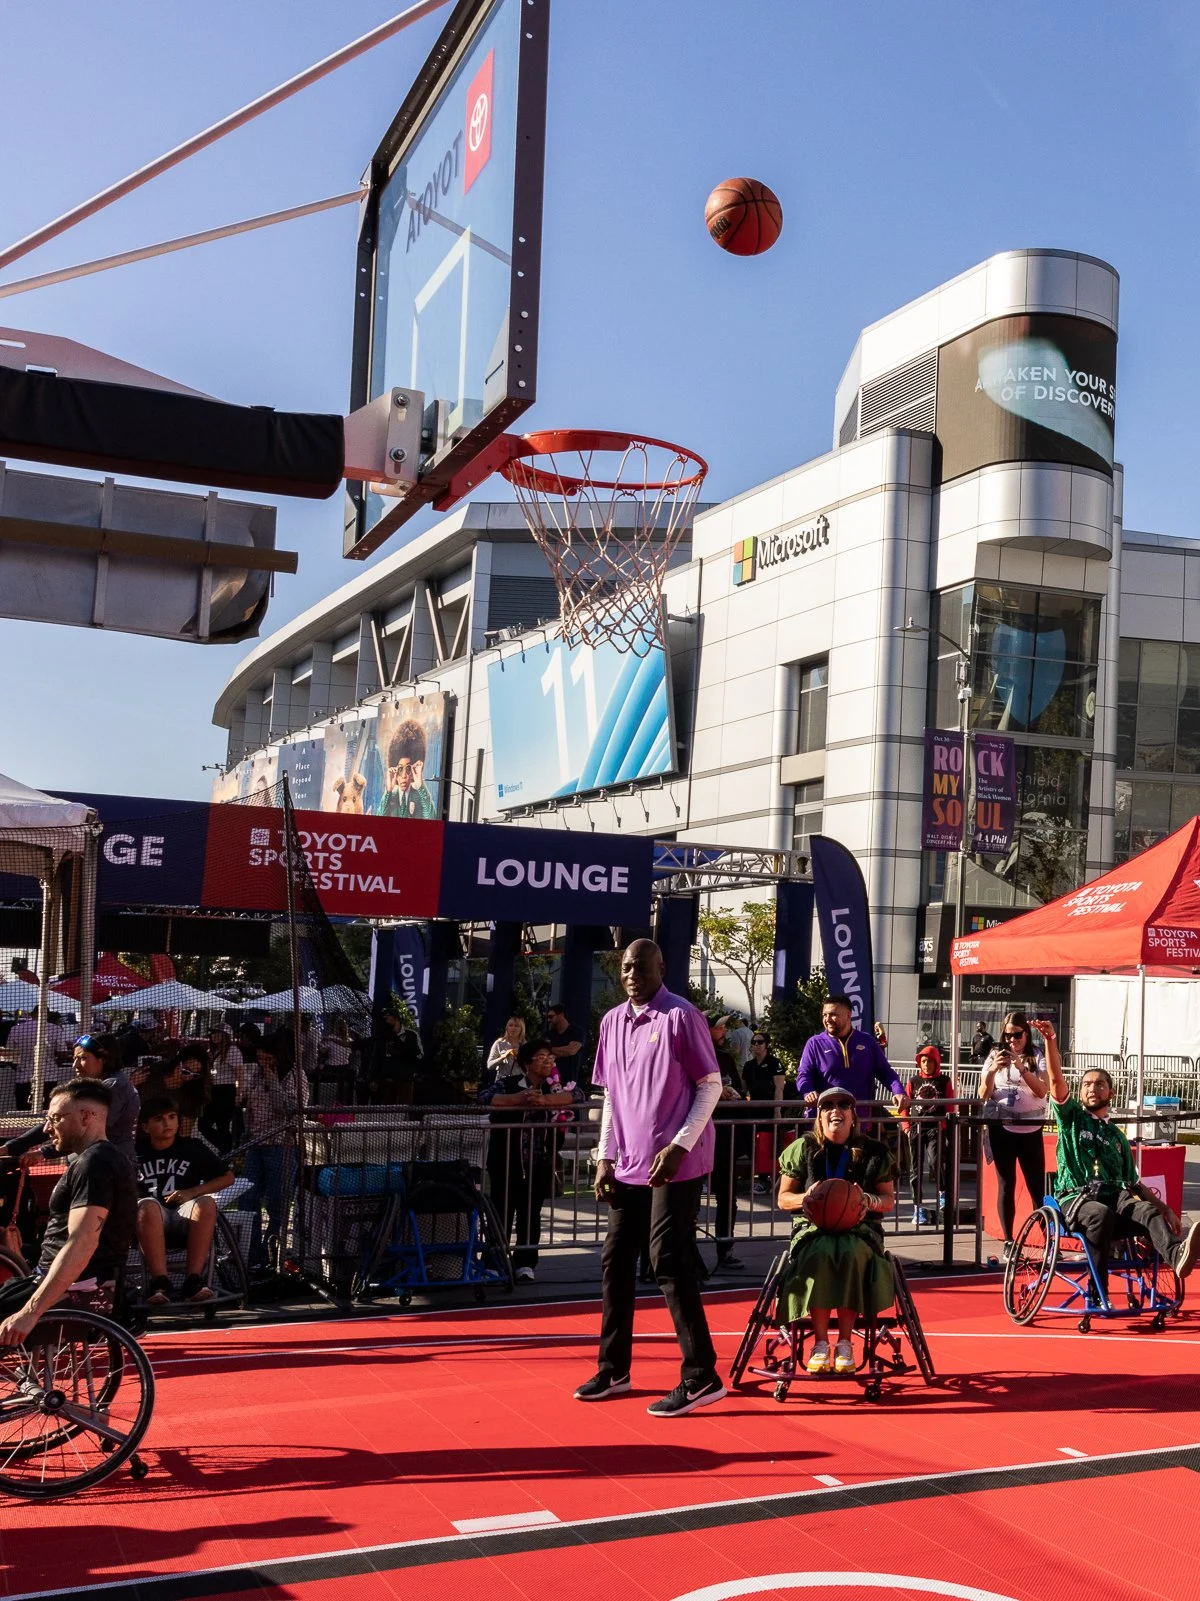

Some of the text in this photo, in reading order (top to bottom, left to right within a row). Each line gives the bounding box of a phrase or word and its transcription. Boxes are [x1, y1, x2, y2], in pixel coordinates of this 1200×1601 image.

[974, 366, 1057, 393] AAKEN
[1065, 368, 1107, 395] YOUR
[1001, 385, 1026, 402] OF
[756, 513, 830, 570] Microsoft
[933, 773, 960, 796] MY
[991, 834, 1008, 844] Phil
[249, 848, 343, 871] SPORTS
[292, 871, 401, 894] FESTIVAL
[477, 857, 629, 894] LOUNGE
[1091, 881, 1143, 895] TOYOTA
[1062, 893, 1116, 908] SPORTS
[1067, 902, 1128, 917] FESTIVAL
[1157, 928, 1198, 939] TOYOTA
[959, 941, 981, 949] TOYOTA
[1148, 937, 1187, 948] SPORTS
[953, 949, 972, 959] SPORTS
[970, 985, 1012, 995] Box Office
